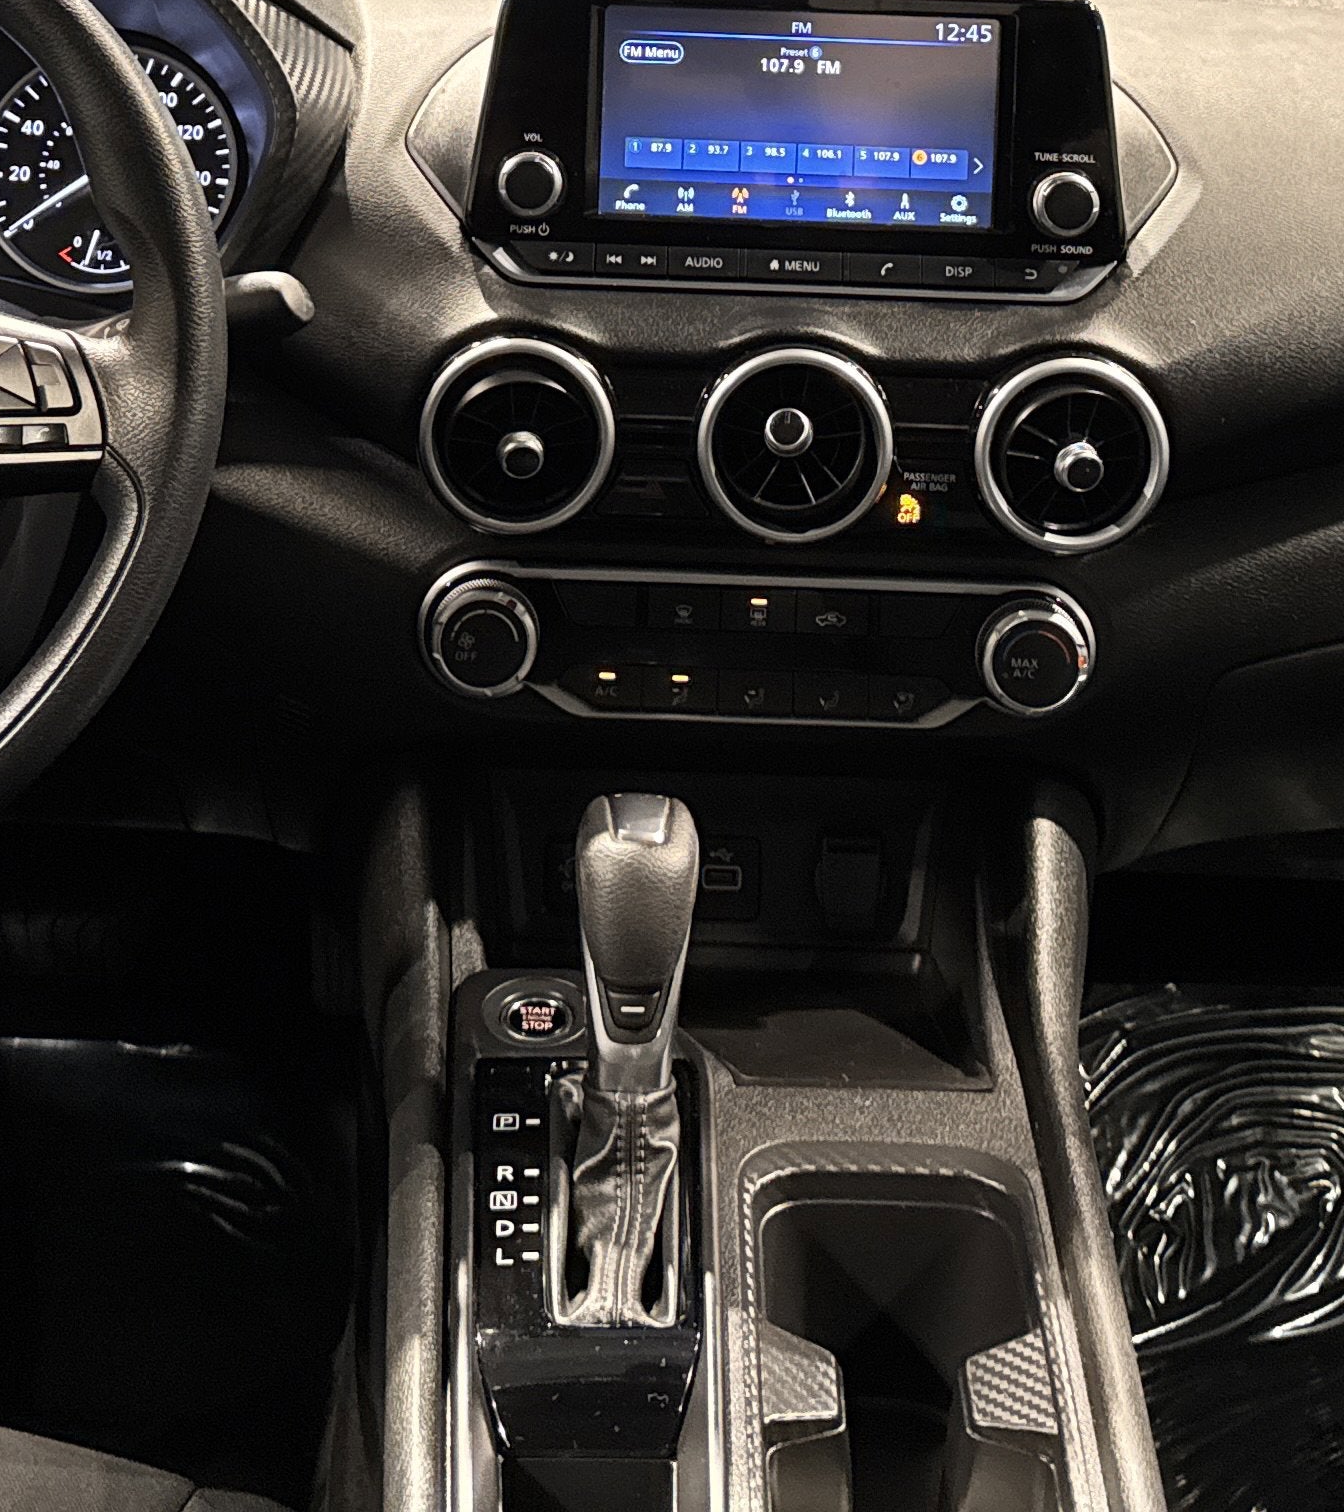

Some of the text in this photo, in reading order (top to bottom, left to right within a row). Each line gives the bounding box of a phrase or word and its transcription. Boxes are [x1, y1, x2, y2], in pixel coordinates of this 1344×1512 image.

[791, 21, 813, 35] FM
[935, 22, 993, 44] 12:45
[623, 45, 679, 59] FM Menu
[780, 47, 808, 58] Preset
[760, 57, 841, 75] 107.9 FM
[20, 119, 45, 137] 40
[523, 132, 543, 143] VOL
[873, 151, 900, 162] 107.9
[8, 165, 31, 183] 20
[614, 199, 646, 212] Phone
[676, 202, 694, 213] AM
[731, 204, 748, 215] FM
[825, 208, 872, 221] Bluetooth
[892, 211, 916, 221] AUX
[939, 212, 977, 226] Settings
[509, 224, 536, 234] PUSH
[1031, 243, 1093, 256] PUSH SOUND
[684, 256, 723, 269] AUDIO
[784, 259, 820, 273] MENU
[945, 265, 973, 278] DISP
[903, 471, 958, 483] PASSENGER
[910, 482, 949, 493] AIR BAG
[896, 512, 921, 525] OFF
[454, 650, 478, 662] OFF
[1010, 657, 1040, 669] MAX
[1012, 668, 1036, 680] A/C
[519, 1005, 557, 1017] START
[521, 1020, 554, 1031] STOP
[497, 1166, 514, 1182] R
[495, 1194, 513, 1207] N
[495, 1219, 515, 1237] D
[496, 1247, 514, 1266] L
